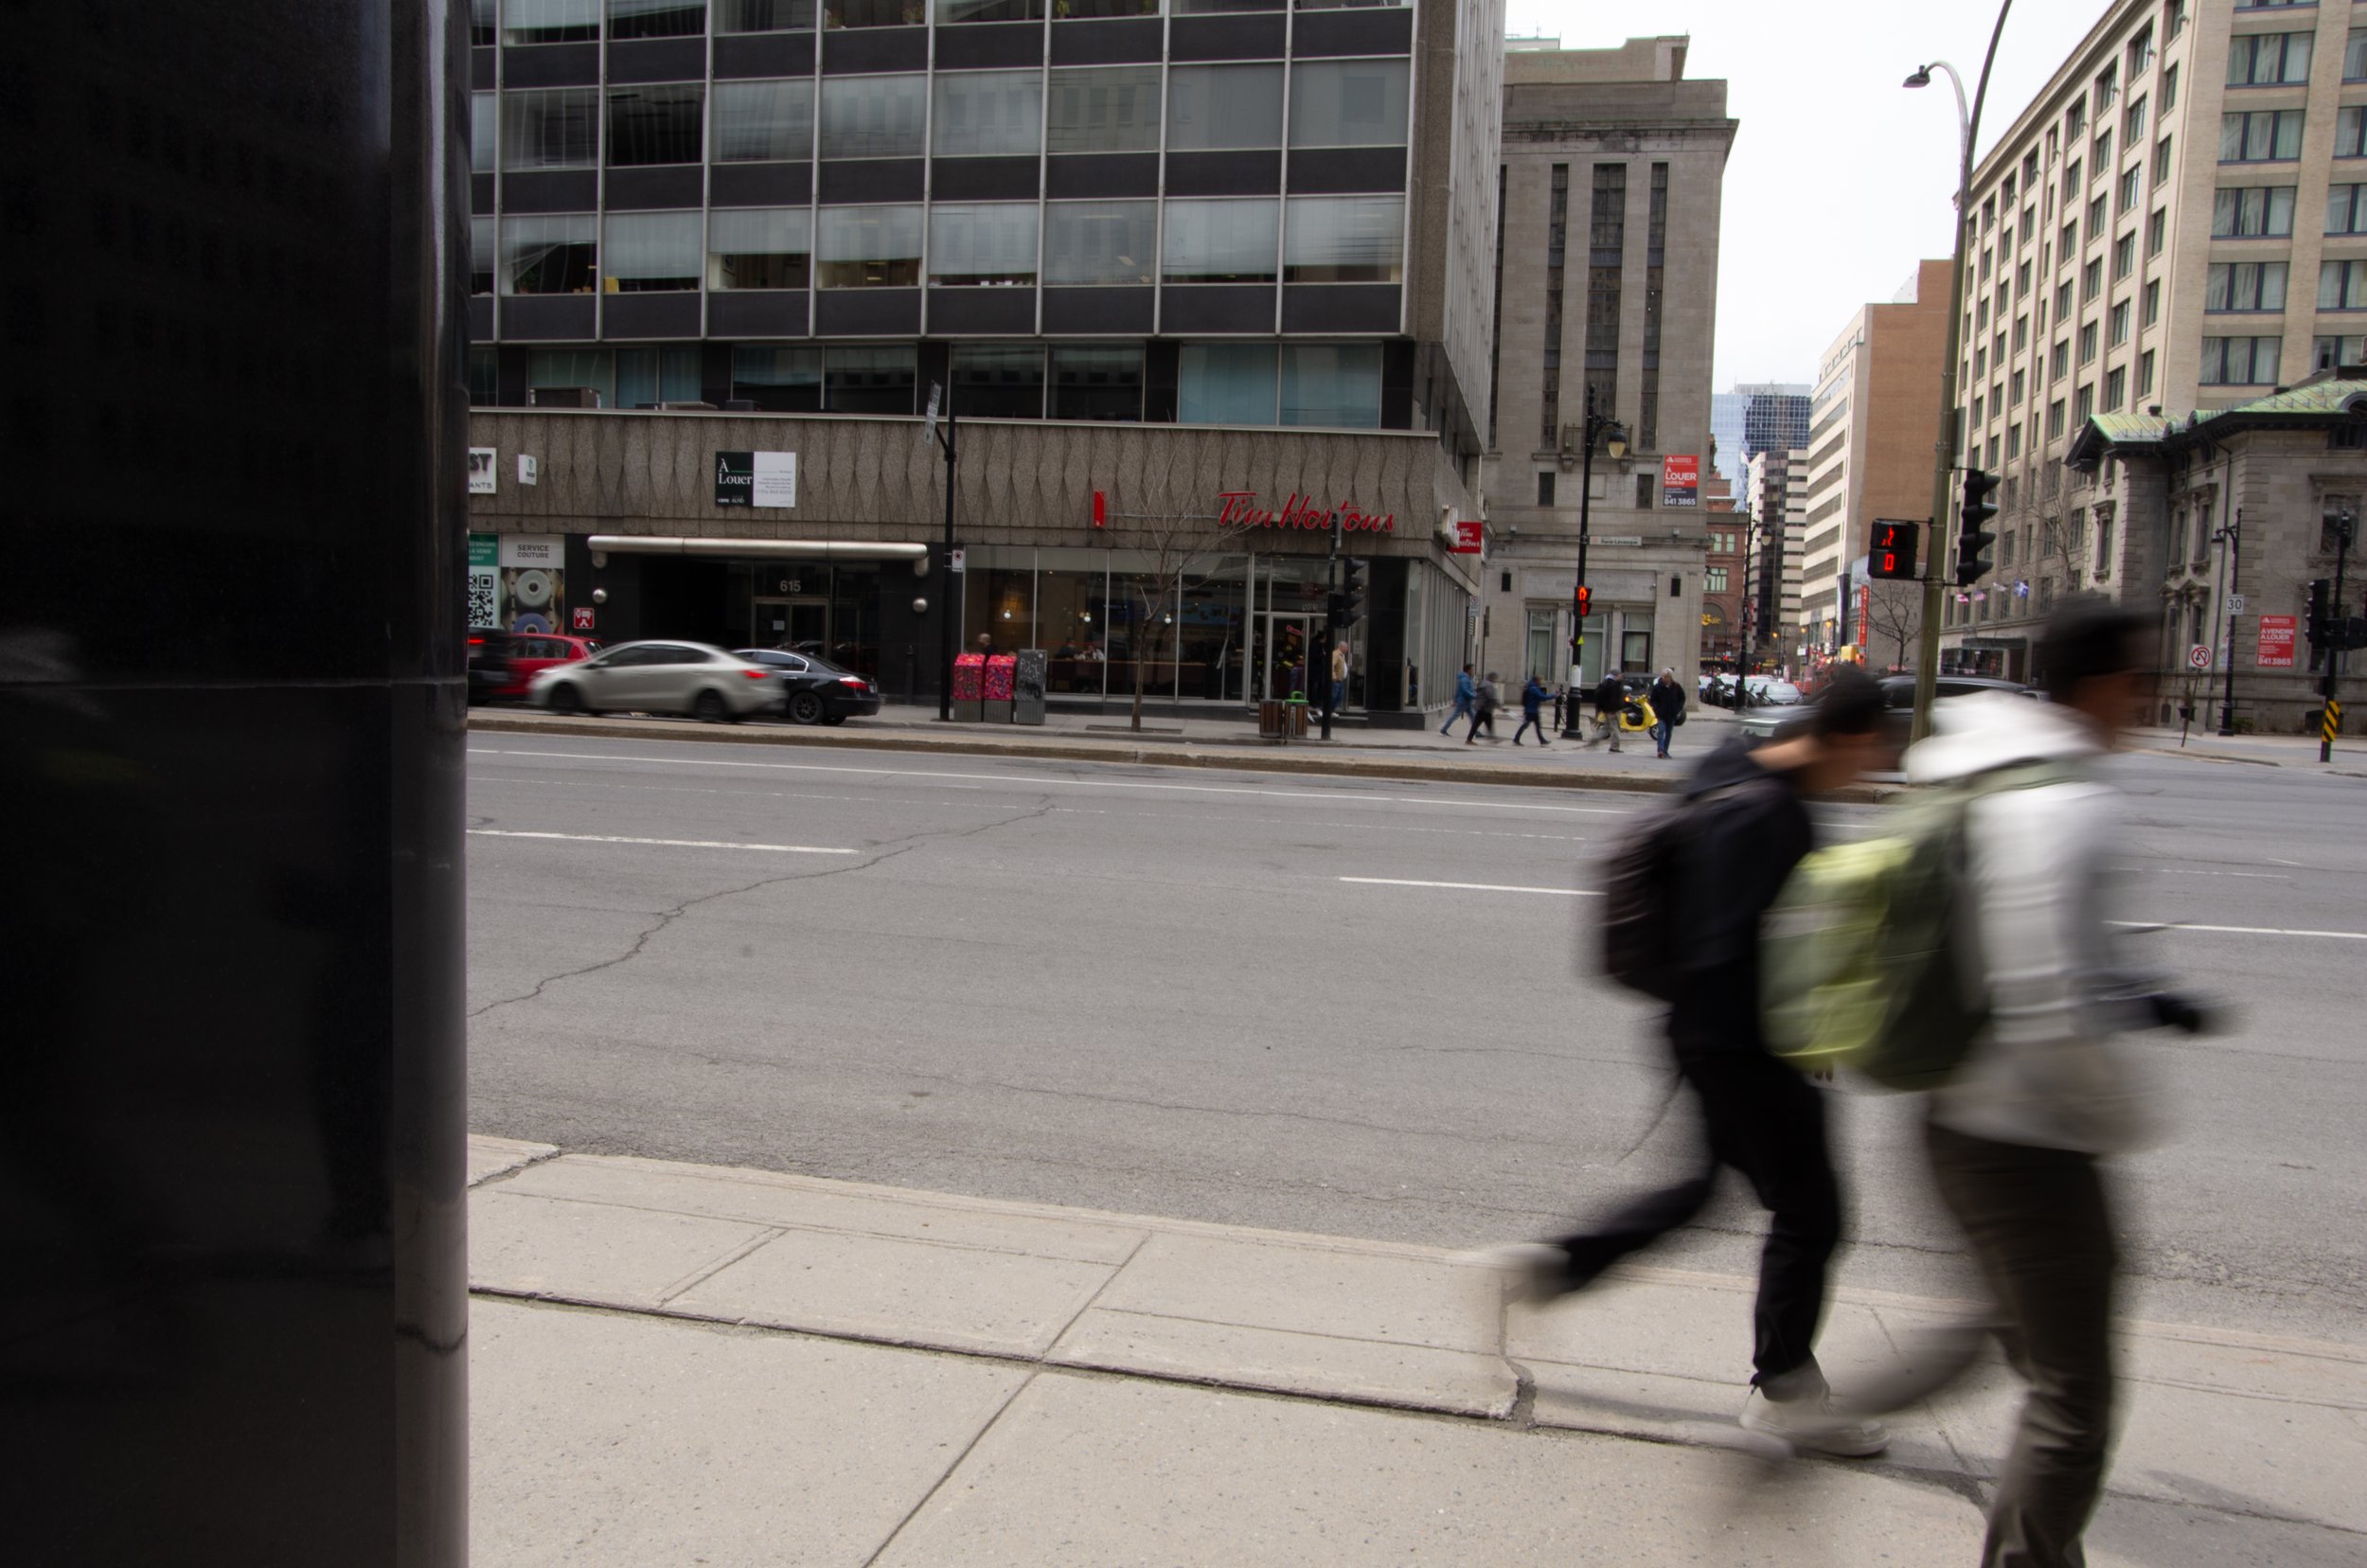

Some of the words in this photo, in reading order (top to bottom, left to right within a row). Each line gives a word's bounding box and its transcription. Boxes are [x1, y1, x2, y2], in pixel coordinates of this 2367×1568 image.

[719, 457, 729, 472] À
[718, 472, 753, 485] Louer
[1665, 472, 1697, 481] LOUER
[1218, 491, 1272, 527] Tim
[1460, 527, 1474, 538] Tim
[780, 579, 801, 592] 615
[2228, 599, 2242, 610] 30
